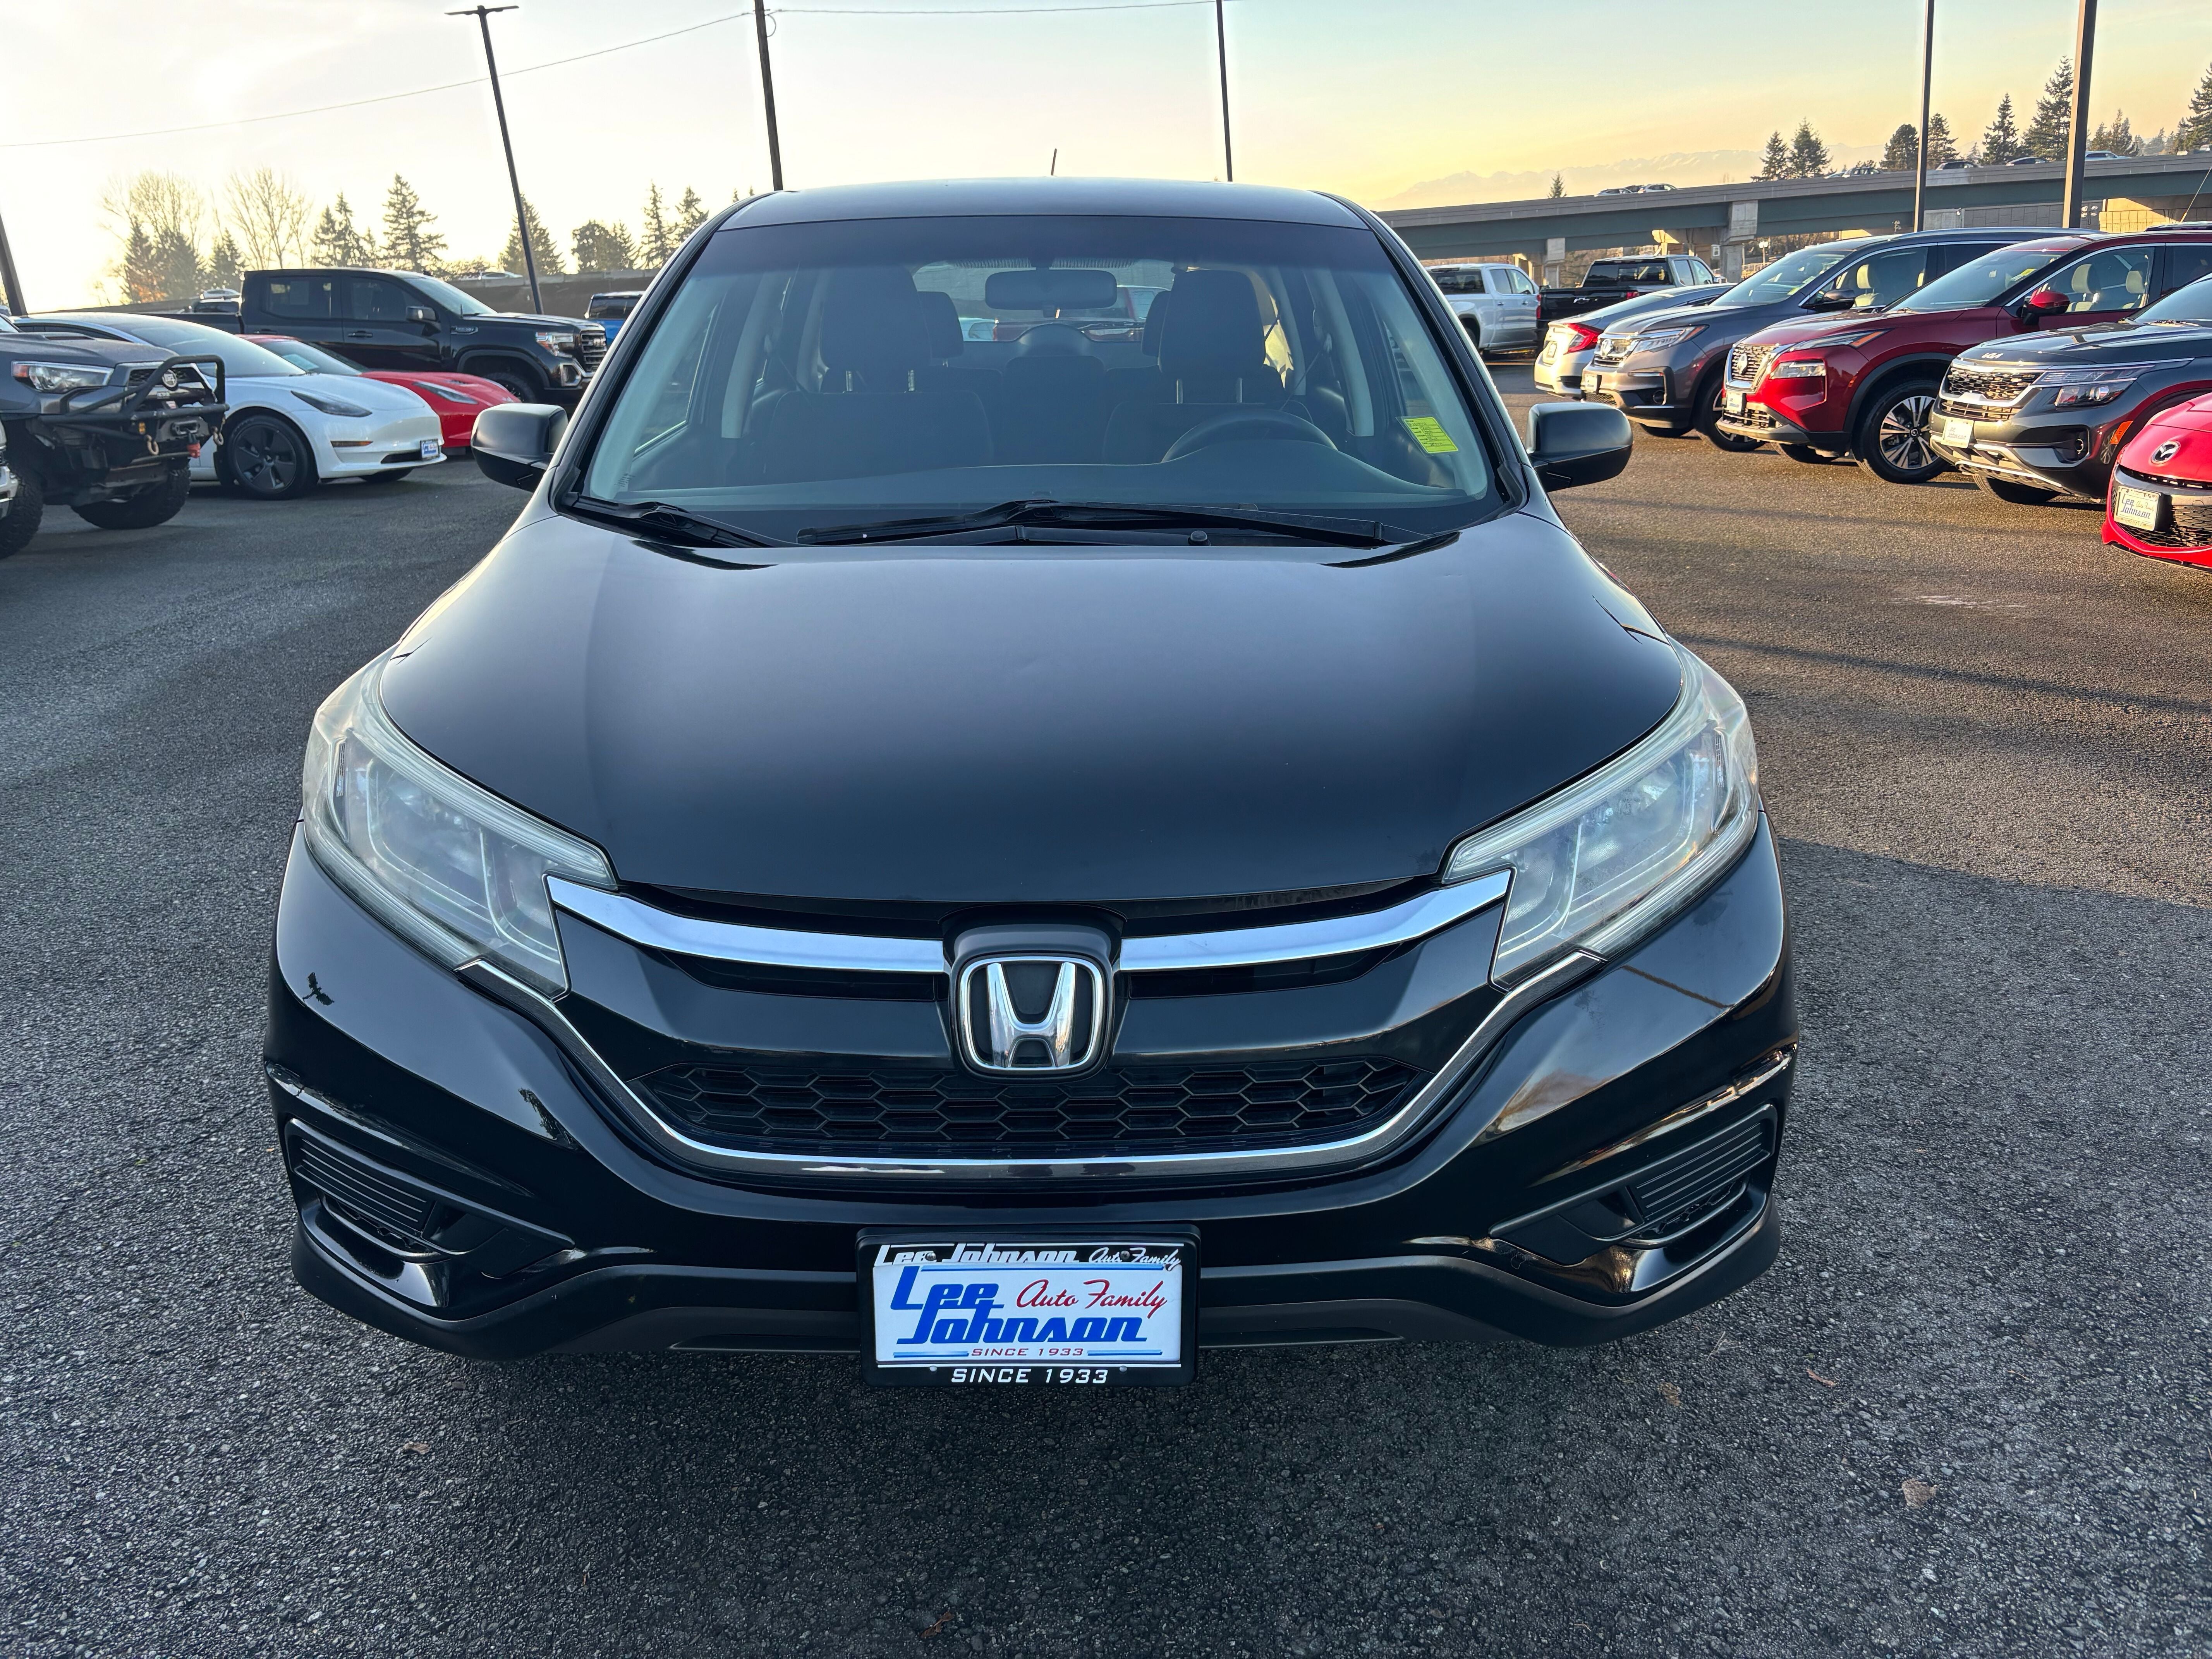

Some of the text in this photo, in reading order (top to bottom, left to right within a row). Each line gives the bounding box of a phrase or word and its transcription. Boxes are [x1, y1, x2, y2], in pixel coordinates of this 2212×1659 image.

[874, 1245, 936, 1266] Lee
[942, 1243, 1079, 1263] Johnson
[1129, 1247, 1181, 1271] Family
[891, 1266, 1168, 1319] Lee Auto Family
[896, 1305, 1147, 1344] Johnson
[971, 1348, 1084, 1357] SINCE 1933
[951, 1368, 1108, 1384] SINCE 1933
